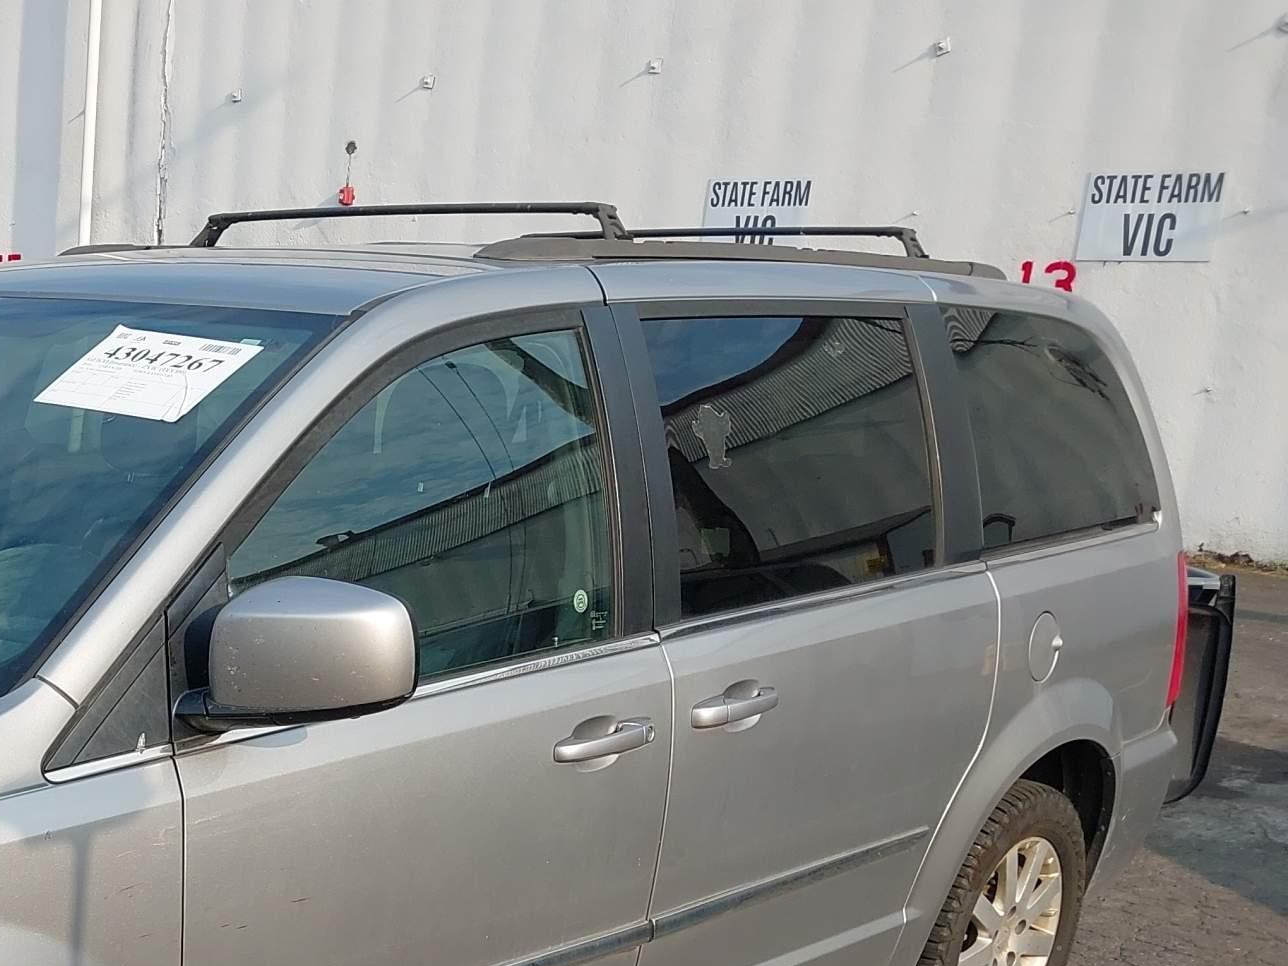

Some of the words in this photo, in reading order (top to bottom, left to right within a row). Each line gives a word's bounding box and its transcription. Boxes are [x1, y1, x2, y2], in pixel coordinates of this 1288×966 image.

[710, 181, 758, 208] STATE
[760, 179, 812, 207] FARM
[1090, 174, 1154, 205] STATE
[1156, 171, 1226, 204] FARM
[1121, 212, 1178, 257] VIC
[103, 345, 226, 373] 43047267
